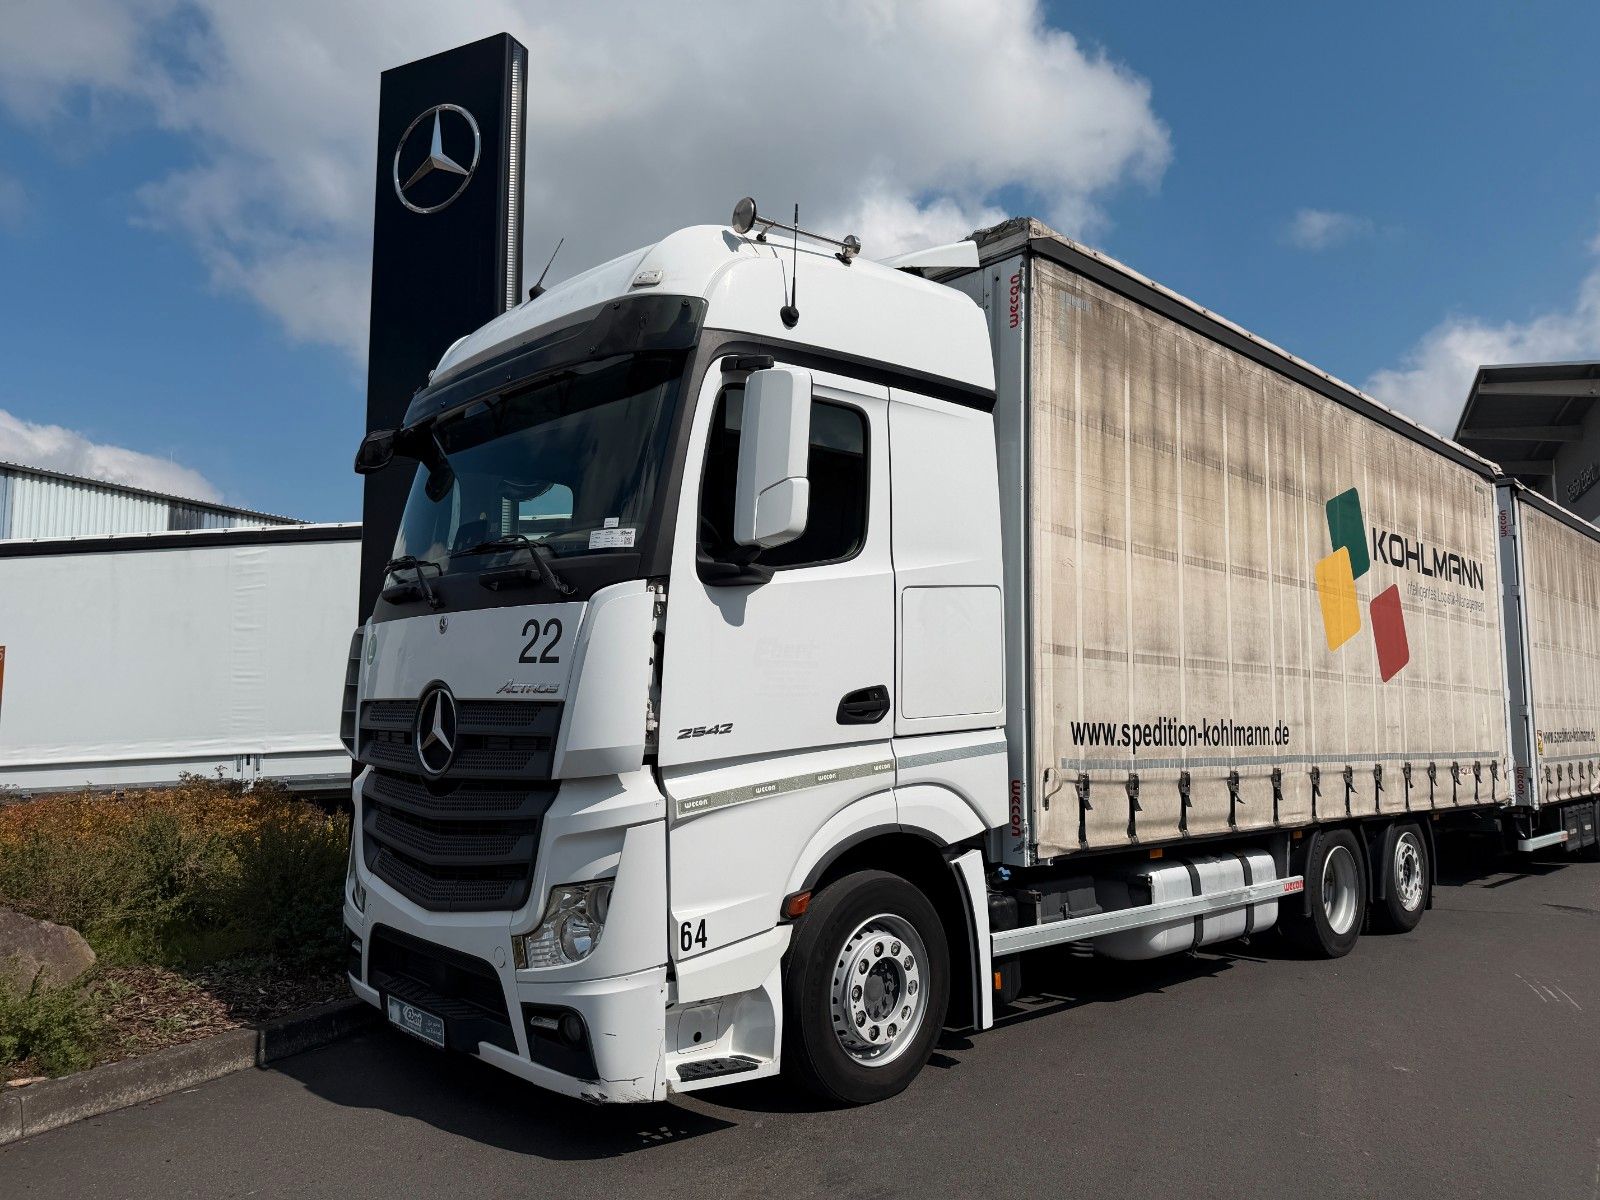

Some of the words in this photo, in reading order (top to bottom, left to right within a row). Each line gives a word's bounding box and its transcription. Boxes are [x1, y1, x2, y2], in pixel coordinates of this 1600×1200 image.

[1010, 274, 1020, 329] wecon
[1372, 527, 1484, 591] KOHLMANN
[518, 617, 563, 664] 22
[676, 722, 734, 740] 2542
[1070, 716, 1290, 754] www.spedition-kohlmann.de
[684, 799, 709, 809] wecon
[755, 784, 776, 794] wecon
[1011, 780, 1021, 836] wecon
[680, 918, 708, 952] 64
